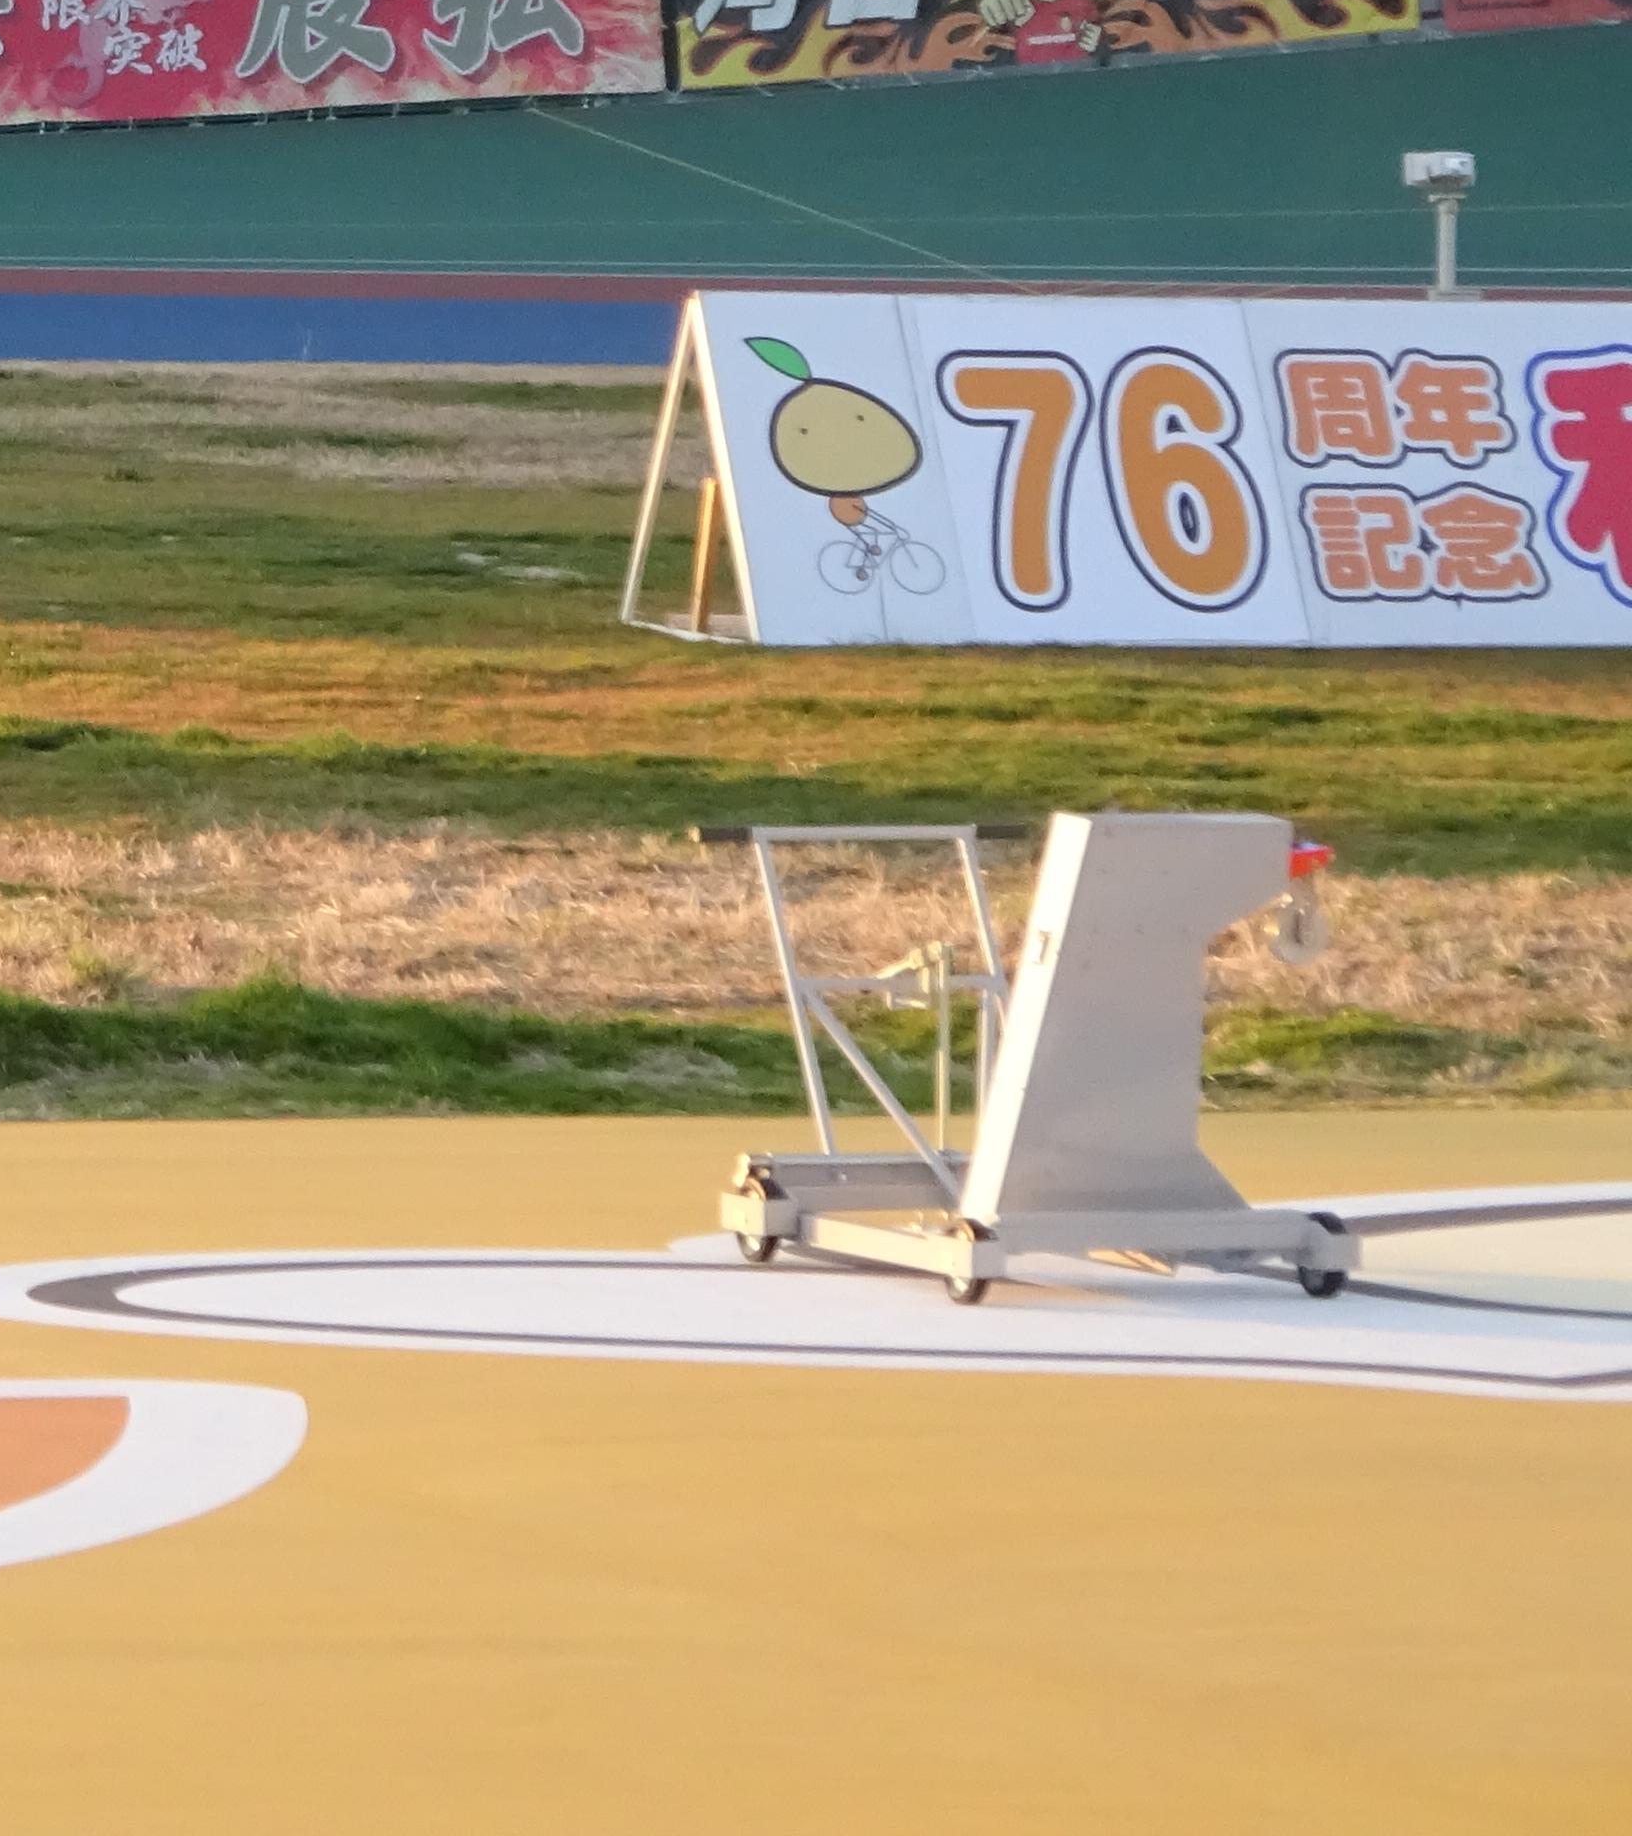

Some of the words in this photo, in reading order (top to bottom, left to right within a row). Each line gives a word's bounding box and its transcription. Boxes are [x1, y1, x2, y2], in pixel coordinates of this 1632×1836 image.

[105, 25, 207, 76] 突破
[1279, 354, 1512, 464] 周年
[944, 352, 1261, 606] 76
[1304, 488, 1544, 596] 記念
